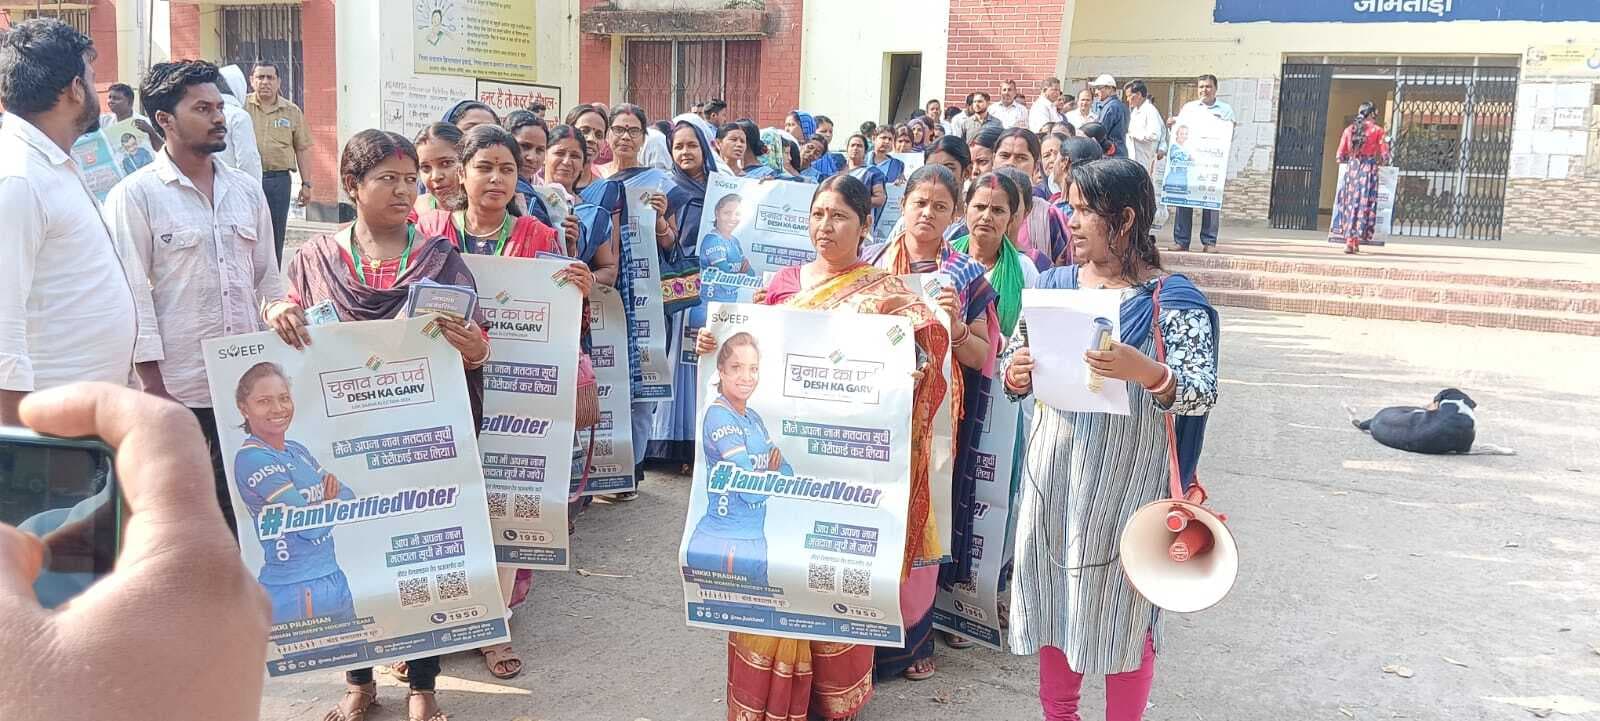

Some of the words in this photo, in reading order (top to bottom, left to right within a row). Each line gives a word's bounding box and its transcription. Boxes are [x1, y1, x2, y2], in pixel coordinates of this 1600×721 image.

[500, 321, 514, 331] KA
[515, 322, 542, 332] GARV
[790, 364, 830, 382] चुनाव
[326, 376, 372, 399] चुनाव
[374, 372, 399, 386] का
[400, 363, 425, 381] पर्व
[803, 379, 829, 391] DESH
[830, 382, 845, 393] KA
[846, 383, 873, 394] GARV
[347, 390, 377, 402] DESH
[377, 388, 394, 399] KA
[394, 384, 425, 396] GARV
[402, 432, 433, 445] मतदाता
[710, 464, 882, 505] #IamVerifiedVoter
[260, 486, 457, 536] #IamVerifiedVoter
[519, 534, 545, 542] 1950
[449, 609, 479, 621] 1950
[850, 608, 877, 618] 1950
